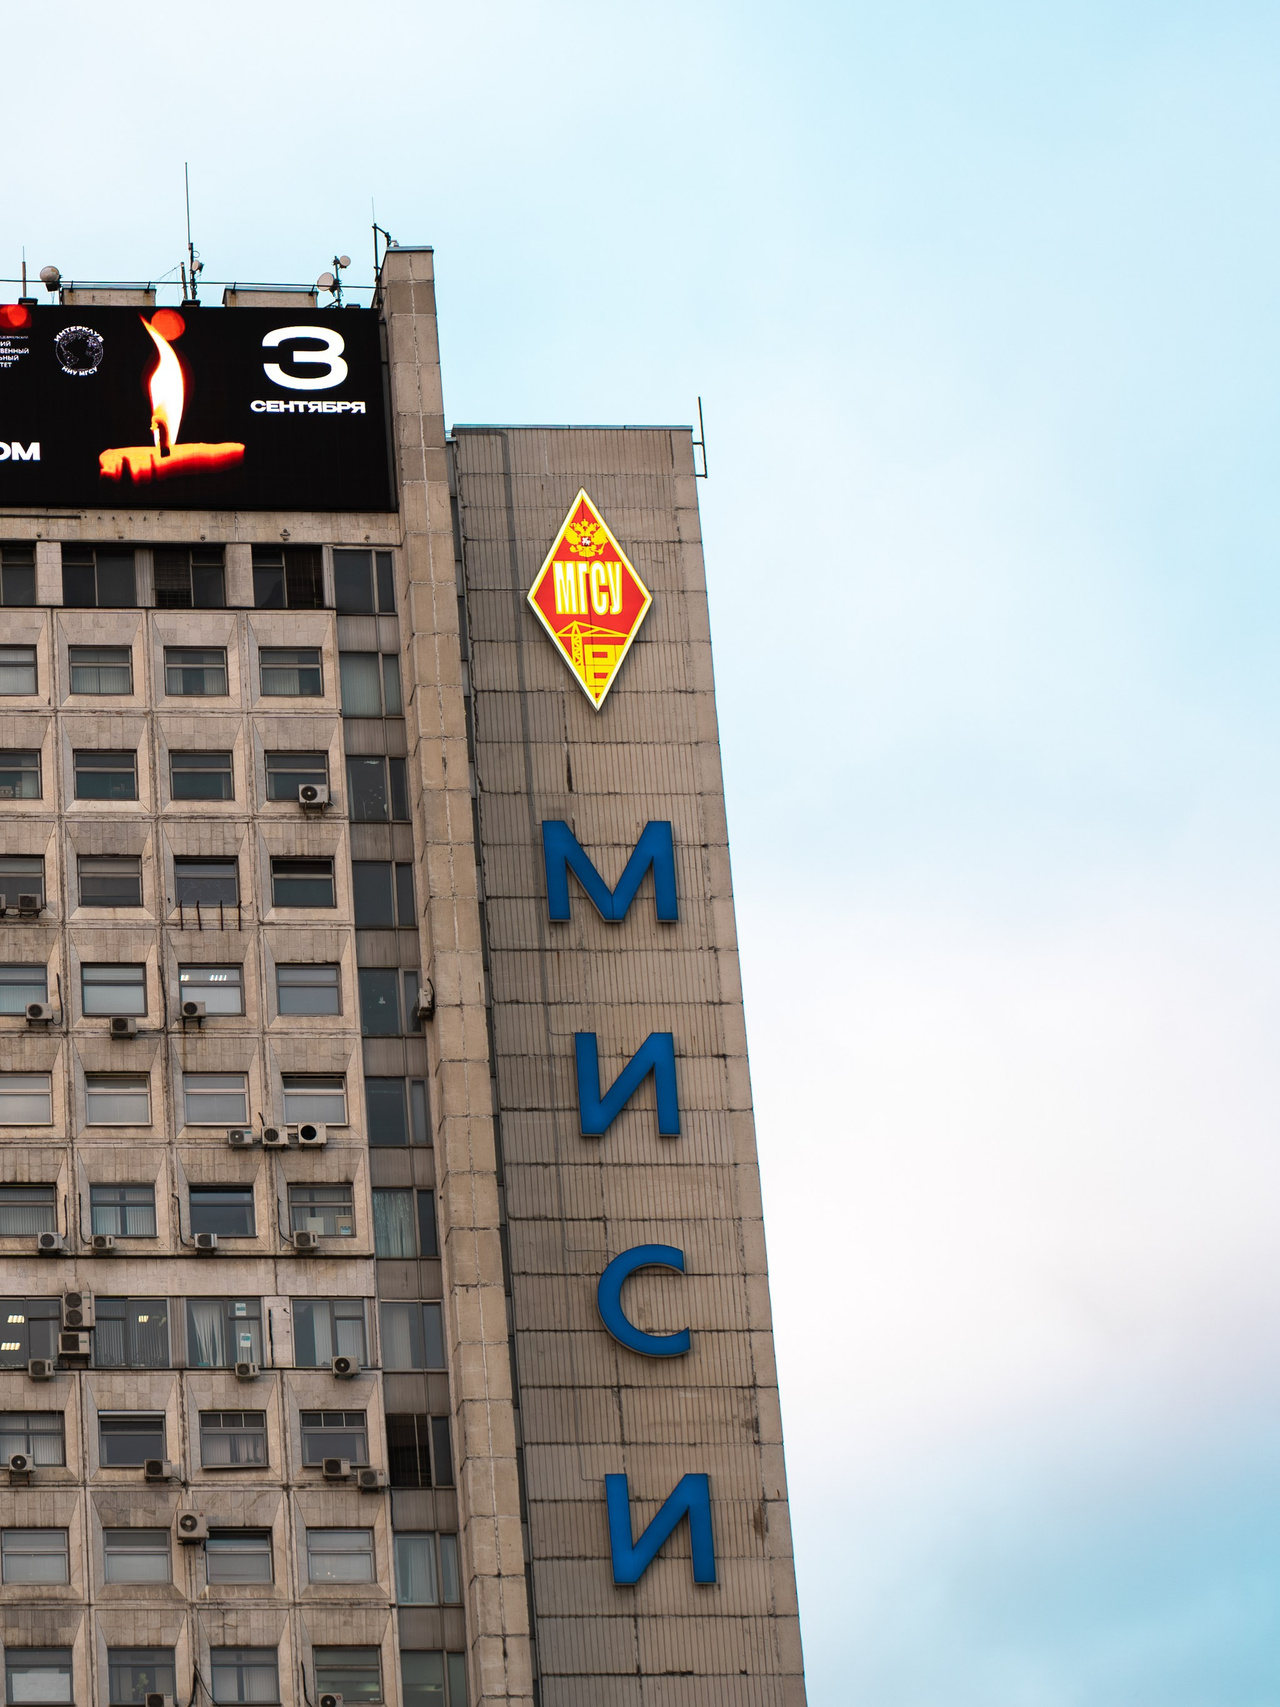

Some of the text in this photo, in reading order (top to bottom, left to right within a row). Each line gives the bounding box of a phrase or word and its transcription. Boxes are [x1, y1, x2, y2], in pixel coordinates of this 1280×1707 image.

[262, 326, 348, 390] 3
[250, 399, 367, 414] СЕНТЯБРЯ
[552, 560, 623, 616] МГСУ
